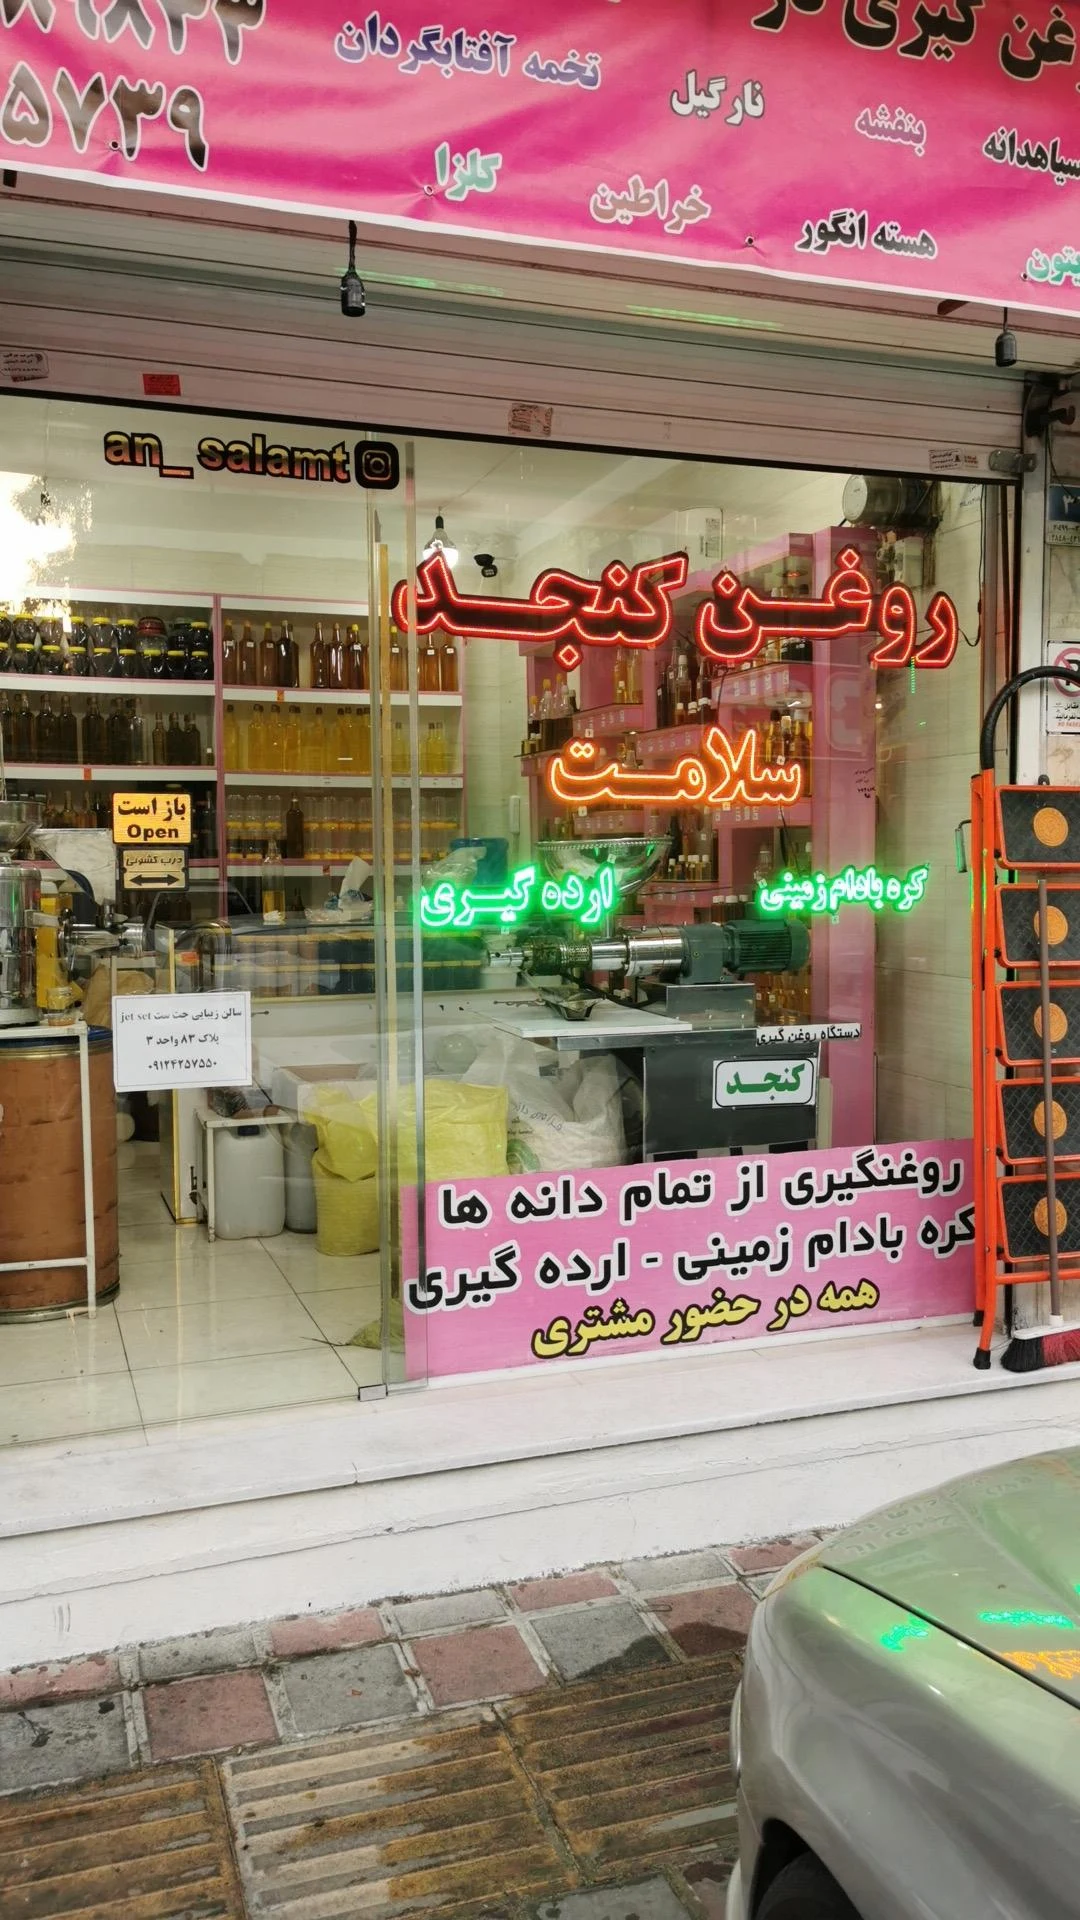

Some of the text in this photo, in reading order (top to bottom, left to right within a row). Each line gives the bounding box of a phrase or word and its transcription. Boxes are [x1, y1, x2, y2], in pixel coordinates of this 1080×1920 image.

[523, 48, 602, 89] تخمه
[0, 60, 209, 171] ۵۷۳۹
[670, 69, 765, 125] نارگیل
[855, 104, 927, 156] بنفشه
[434, 141, 502, 202] کلزا
[589, 174, 711, 233] خراطین
[794, 208, 938, 260] هسته انگور
[391, 546, 958, 672] روغن کنجد
[547, 725, 804, 806] سلامت
[118, 797, 186, 822] باز است
[127, 824, 179, 841] Open
[160, 857, 183, 866] درب
[419, 865, 616, 928] ارده گیری
[759, 865, 930, 912] کره بادام زمینی
[172, 1011, 188, 1020] جت
[191, 1009, 219, 1020] زیبایی
[221, 1008, 242, 1019] سالن
[757, 1026, 861, 1046] دستگاه روغن گیری
[156, 1035, 179, 1047] واحد
[181, 1034, 195, 1044] ۸۳
[198, 1033, 219, 1045] پلاک
[726, 1063, 806, 1101] کنجد
[442, 1148, 962, 1224] روغنگیری از تمام دانه ها
[677, 1226, 790, 1282] زمینی
[808, 1216, 903, 1268] بادام
[920, 1206, 976, 1254] کره
[408, 1245, 518, 1309] گیری
[539, 1242, 626, 1292] ارده
[531, 1278, 880, 1359] همه در حضور مشتری
